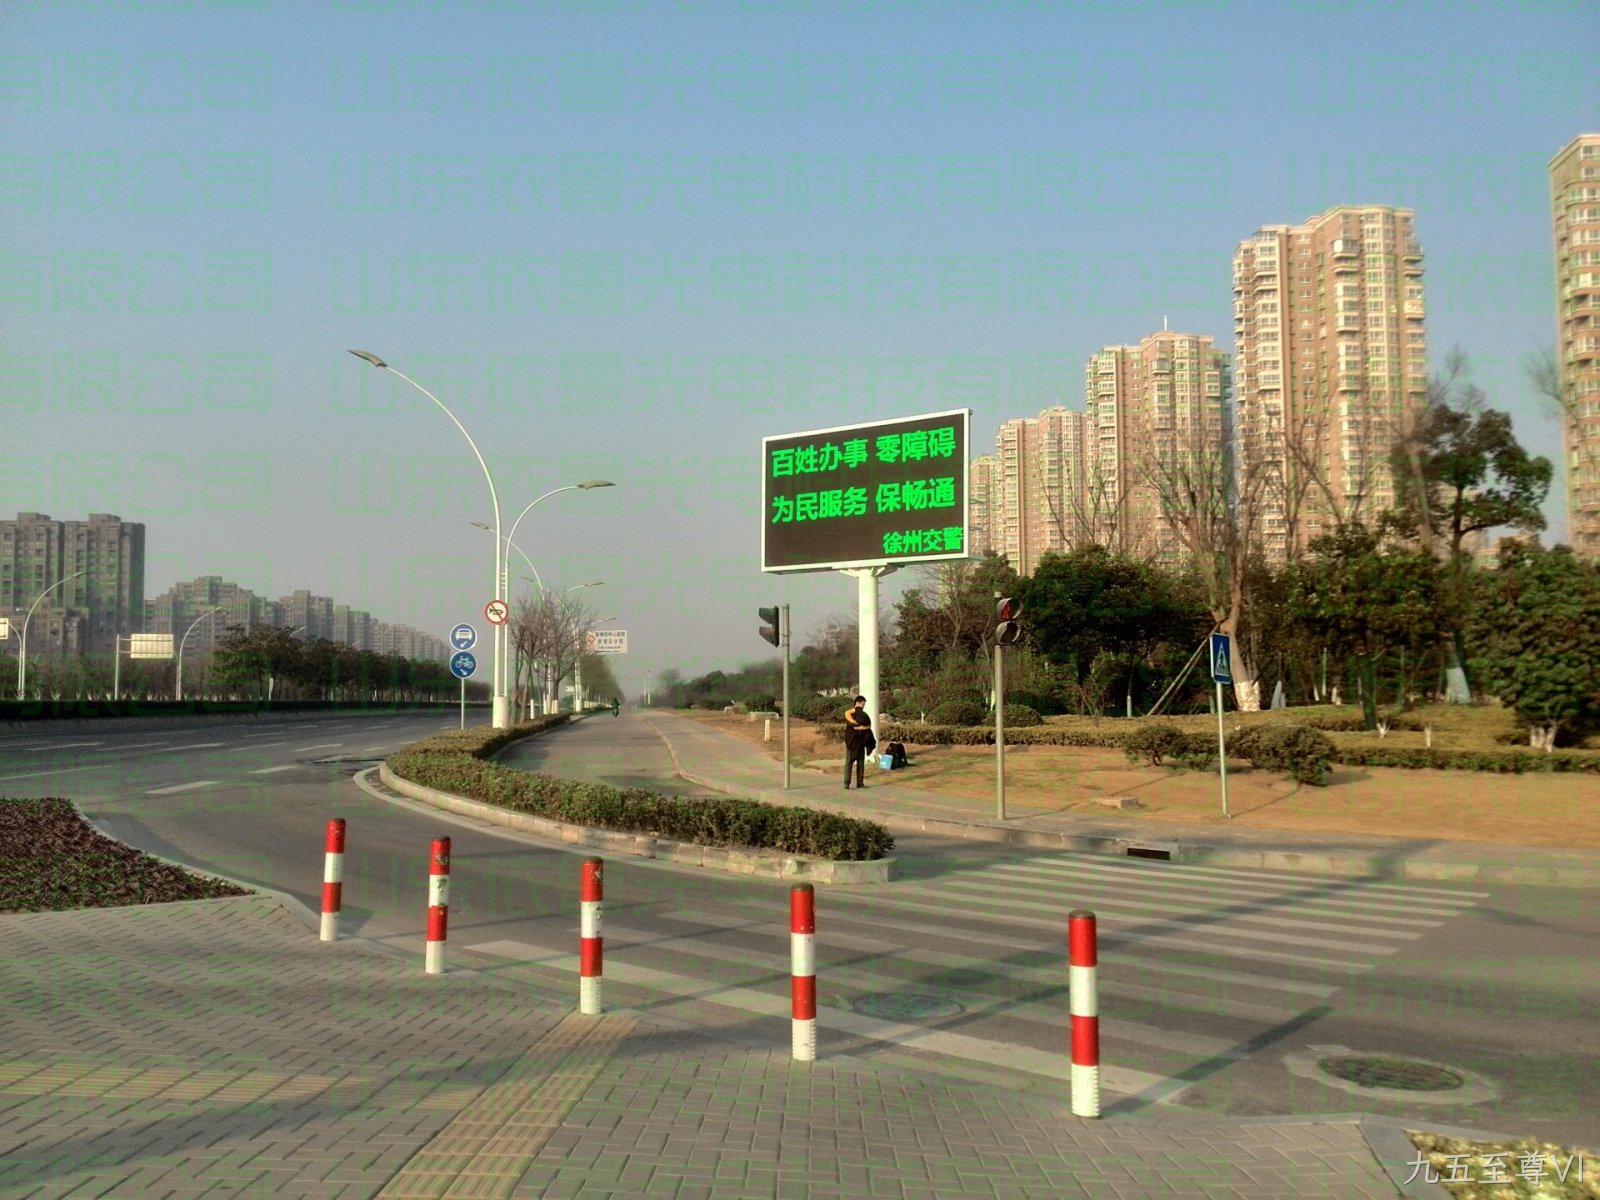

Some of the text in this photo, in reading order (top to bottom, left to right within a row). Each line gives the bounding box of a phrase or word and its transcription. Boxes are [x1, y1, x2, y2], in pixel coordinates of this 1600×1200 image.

[771, 426, 956, 477] 百姓办事 零障碍
[772, 477, 956, 524] 为民服务 保畅通
[883, 526, 964, 554] 徐州交警
